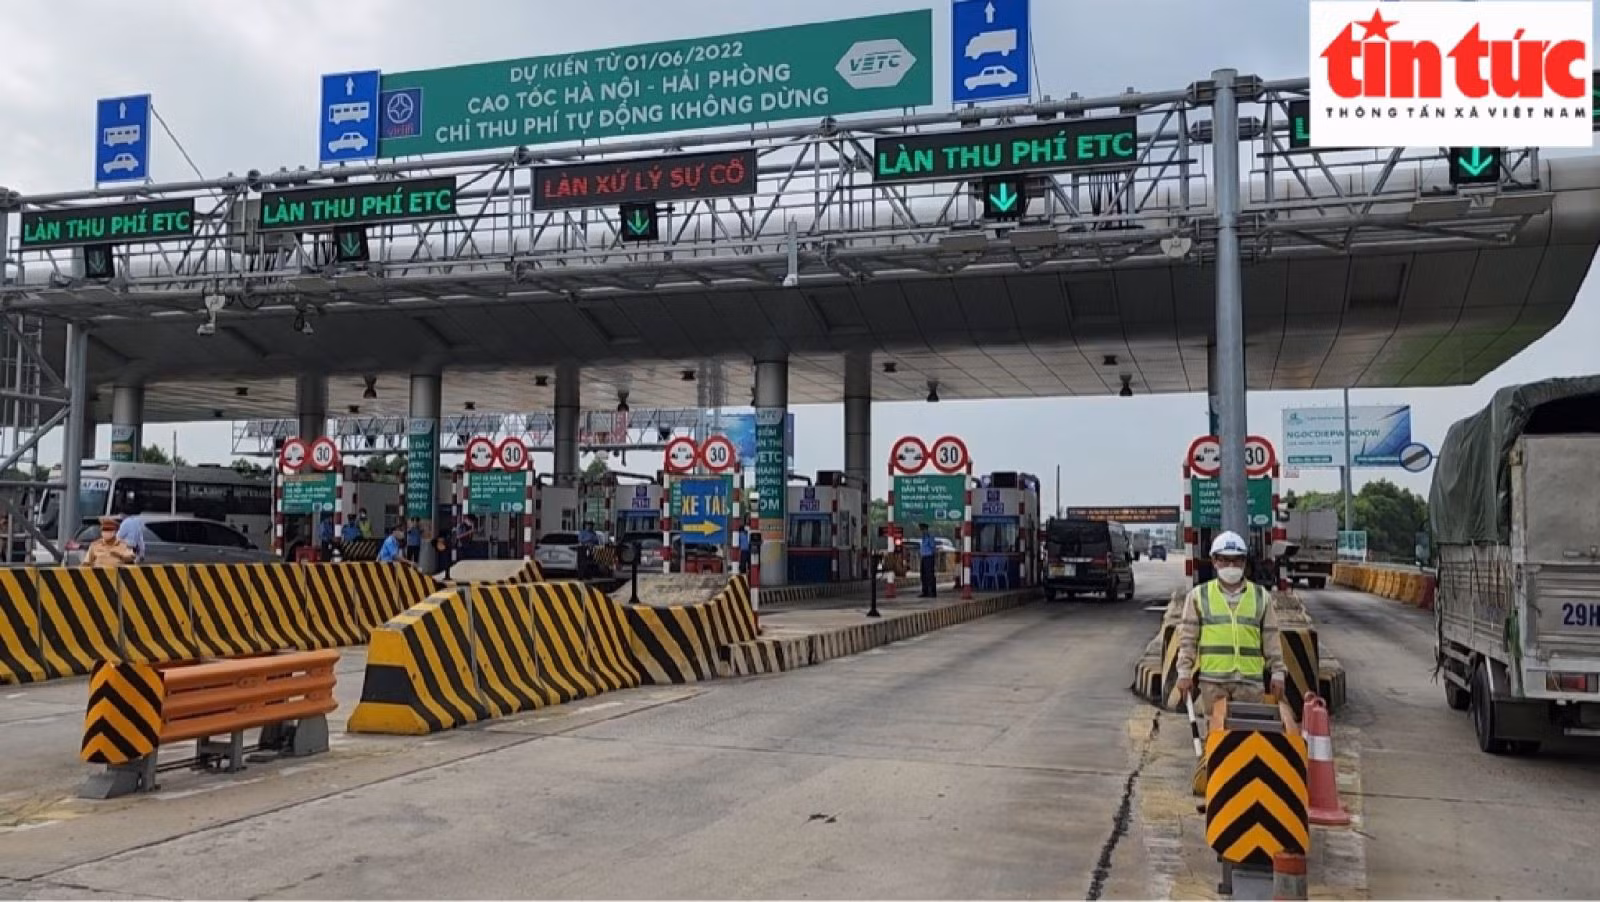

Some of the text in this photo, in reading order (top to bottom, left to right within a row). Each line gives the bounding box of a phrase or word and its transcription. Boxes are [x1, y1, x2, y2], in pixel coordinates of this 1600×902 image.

[510, 40, 744, 85] DỰ KIẾN TỪ 01/06/2022
[849, 50, 902, 74] VETC
[467, 94, 520, 115] CAO
[529, 83, 558, 109] TỐC
[564, 81, 595, 105] HÀ
[601, 78, 641, 103] NỘI
[662, 68, 700, 95] HẢI
[708, 61, 791, 88] PHÒNG
[434, 84, 830, 144] CHỈ THU PHÍ TỰ ĐỘNG KHÔNG DỪNG
[879, 132, 1133, 176] LÀN THU PHÍ ETC
[544, 172, 588, 198] LÀN
[596, 167, 630, 194] XỬ
[635, 165, 663, 191] LÝ
[670, 162, 705, 191] SỰ
[264, 186, 451, 222] LÀN THU PHÍ ETC
[23, 207, 190, 241] LÀN THU PHÍ ETC
[1286, 428, 1380, 439] NGOCDIEPWNDOW
[317, 446, 329, 461] 30
[505, 447, 521, 462] 30
[710, 447, 726, 463] 30
[940, 446, 959, 464] 30
[1245, 447, 1264, 465] 30
[681, 496, 700, 516] XE
